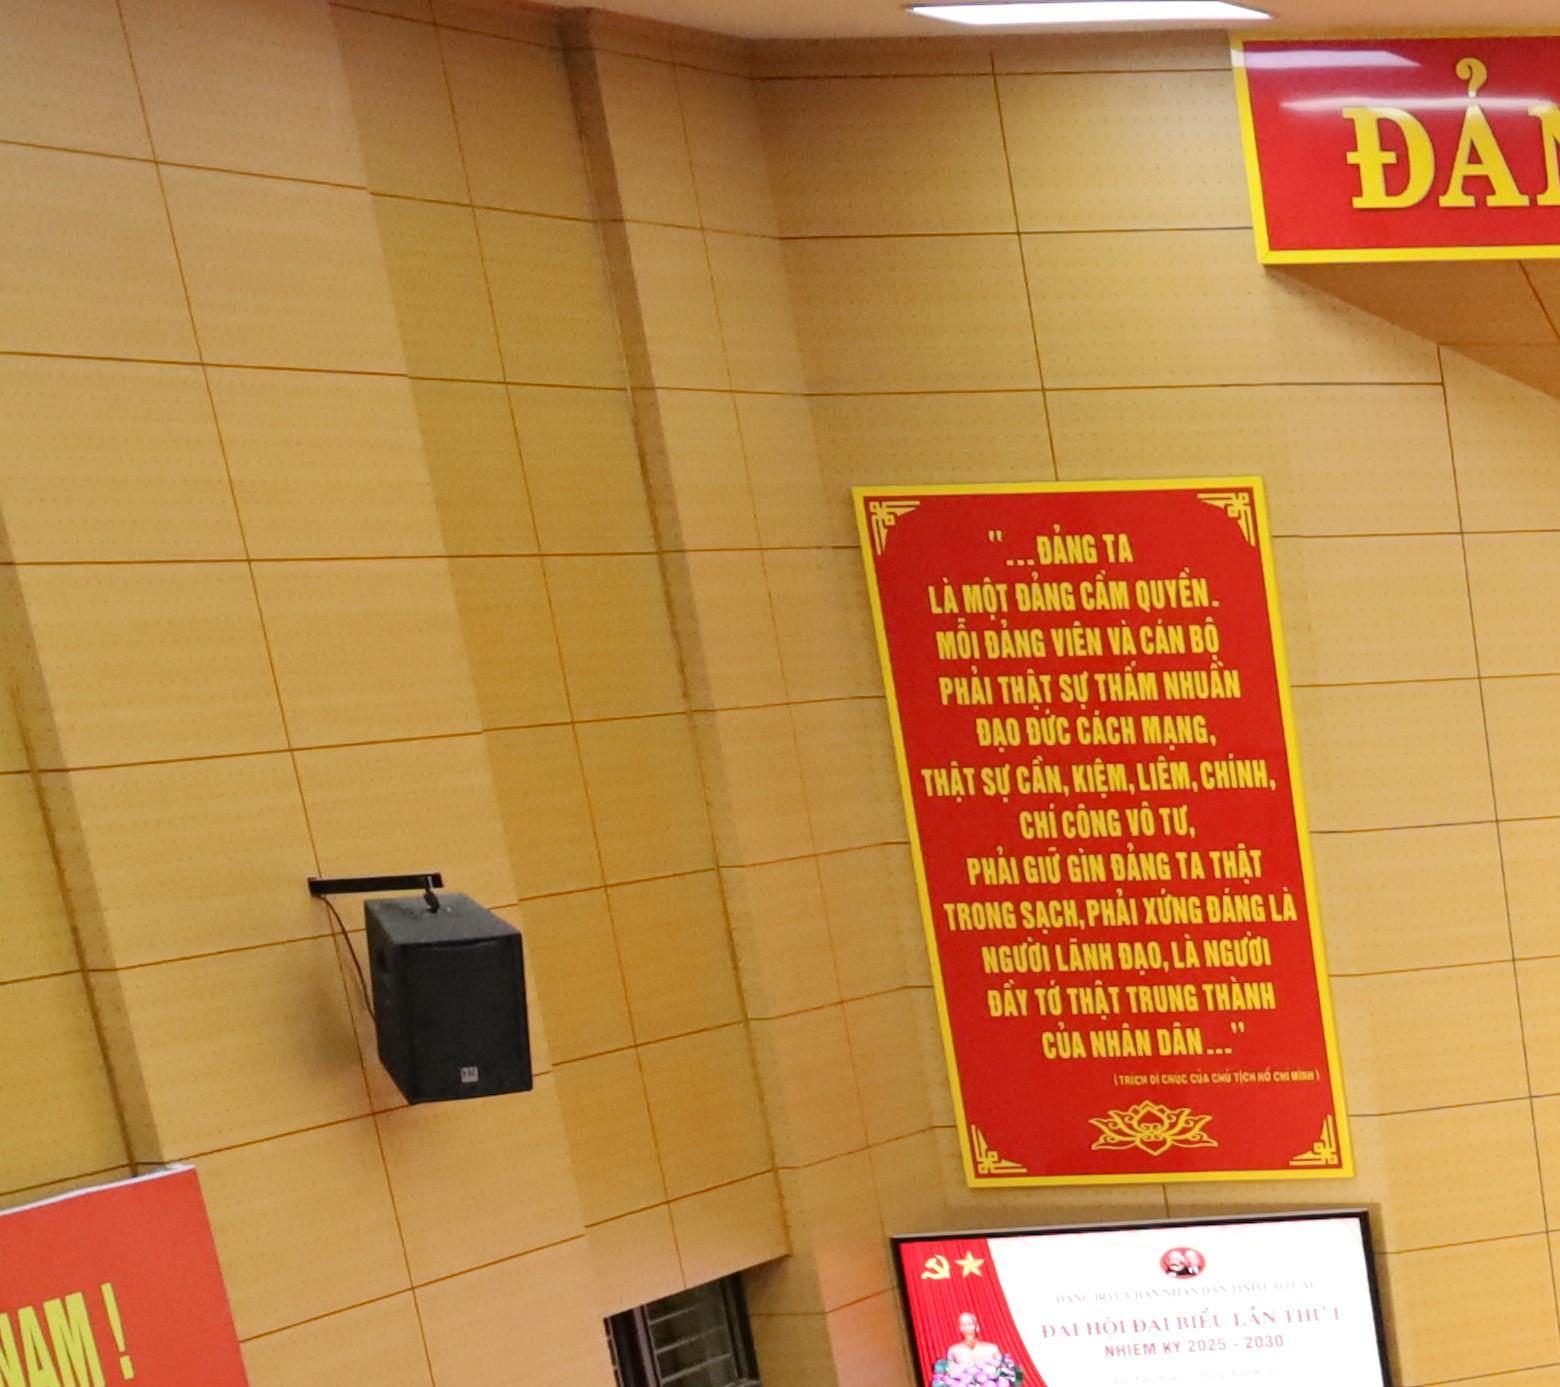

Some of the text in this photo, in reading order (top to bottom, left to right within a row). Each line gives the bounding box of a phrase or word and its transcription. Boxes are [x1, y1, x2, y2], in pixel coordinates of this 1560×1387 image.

[1102, 533, 1134, 563] TA
[928, 577, 959, 614] LÀ
[962, 577, 1008, 620] MỘT
[1015, 571, 1076, 612] ĐẢNG
[1079, 570, 1130, 611] CẦM
[936, 616, 1220, 661] MỖI ĐẢNG VIÊN VÀ CÁN BỘ
[975, 717, 1021, 753] ĐẠO
[1025, 709, 1071, 746] ĐỨC
[1076, 710, 1137, 745] CÁCH
[1019, 803, 1058, 840] CHÍ
[1061, 803, 1122, 839] CÔNG
[1125, 801, 1155, 837] VÔ
[981, 942, 1051, 973] NGƯỜI
[1055, 938, 1114, 972] LÃNH
[1170, 934, 1201, 969] LÀ
[1203, 931, 1272, 968] NGƯỜI
[987, 976, 1276, 1020] ĐẦY TỚ THẬT TRUNG THÀNH
[1042, 1021, 1087, 1059] CỦA
[1089, 1022, 1152, 1058] NHÂN
[101, 1281, 134, 1380] !
